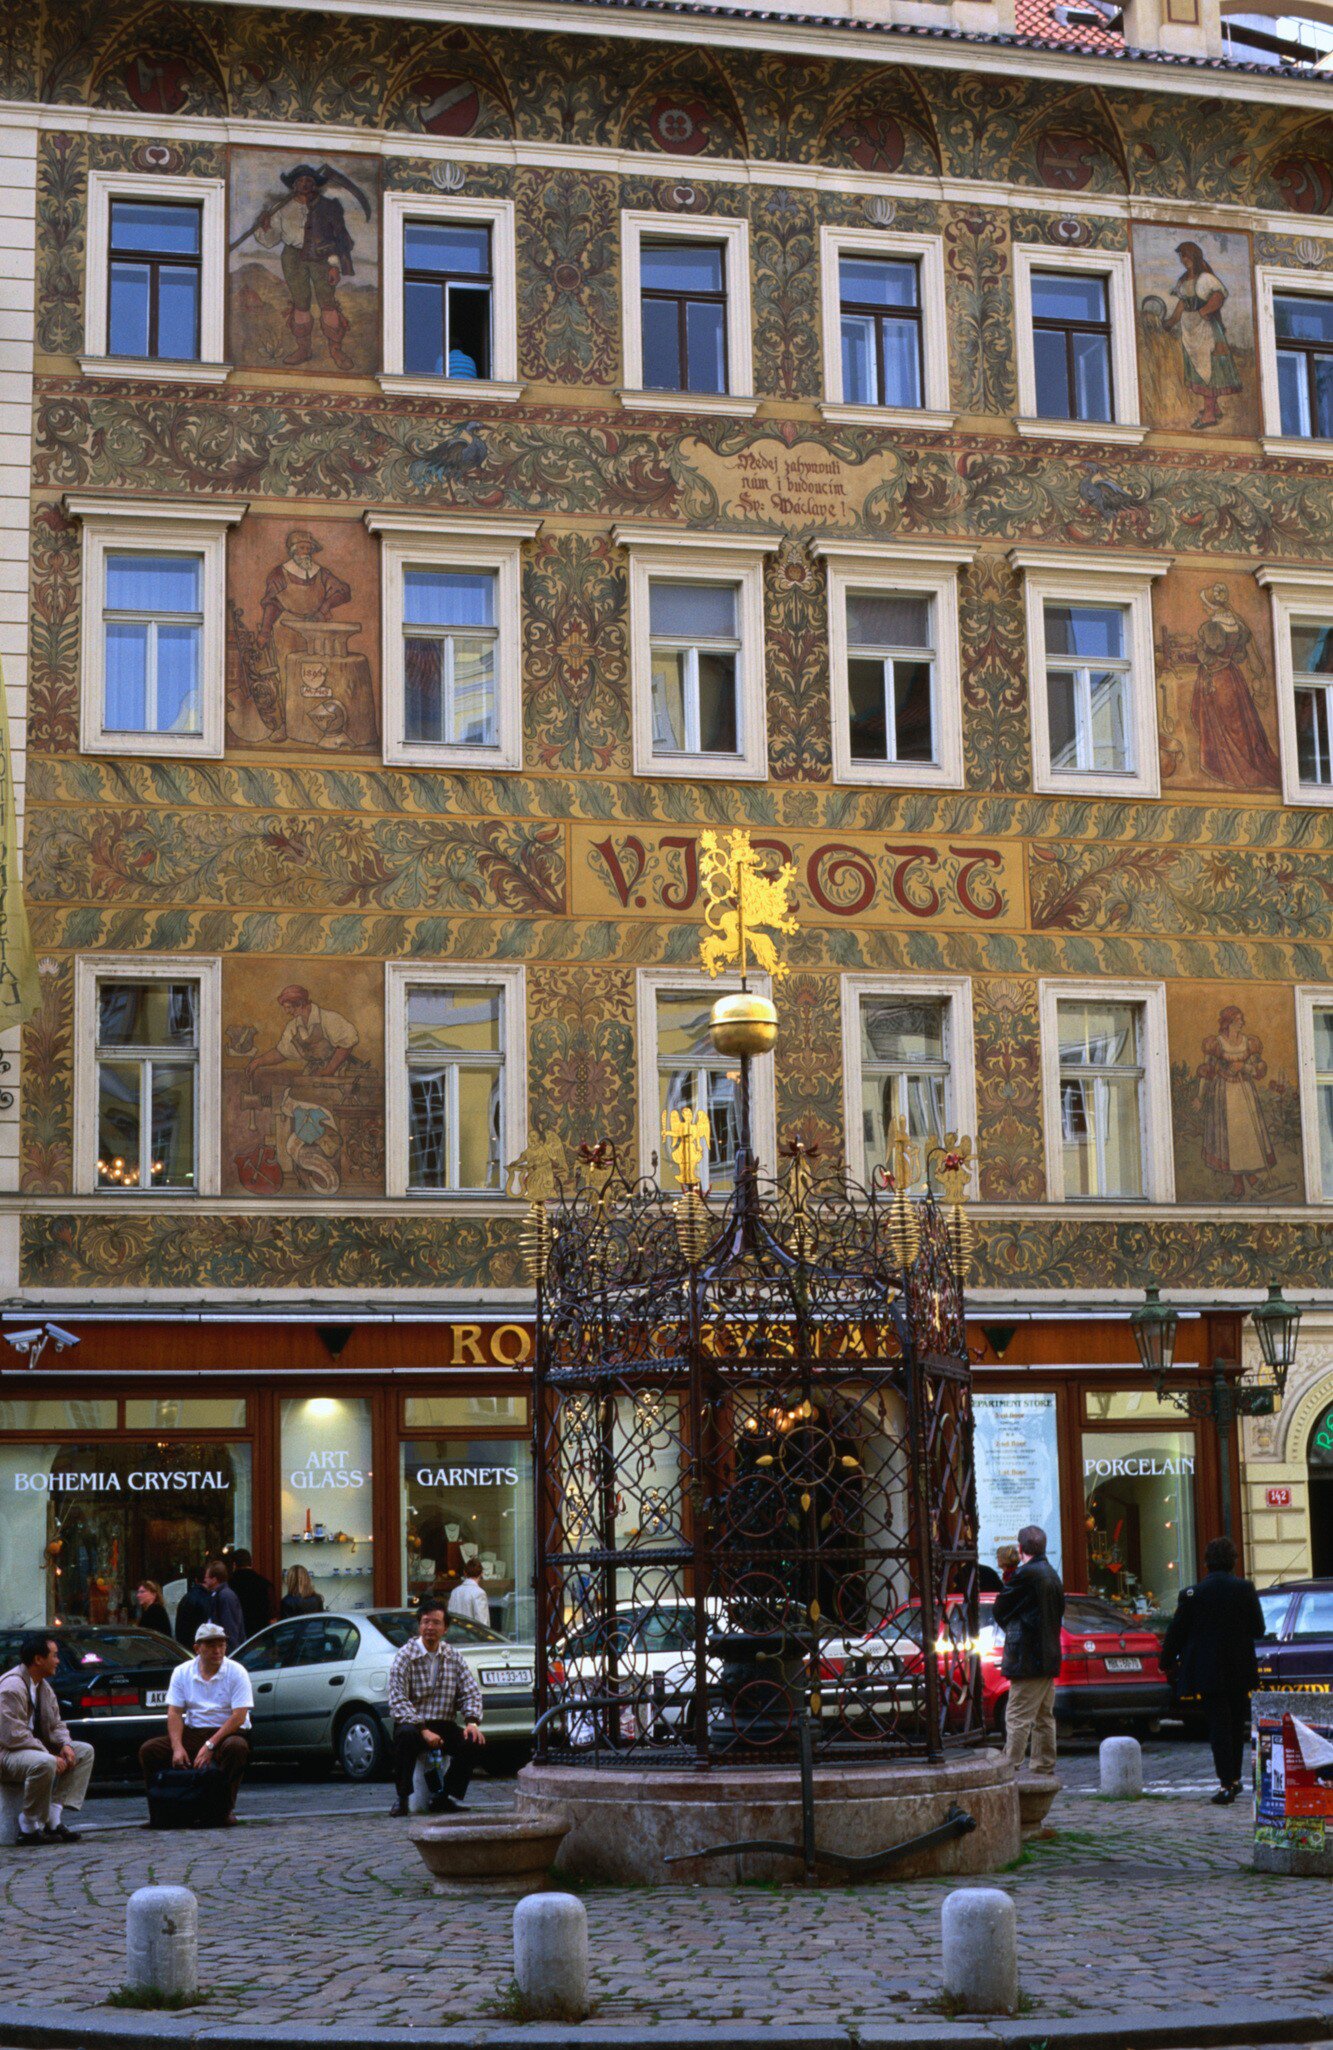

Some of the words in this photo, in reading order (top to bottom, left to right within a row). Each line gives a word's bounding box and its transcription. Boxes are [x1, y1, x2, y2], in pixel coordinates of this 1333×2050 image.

[742, 473, 771, 491] nám
[971, 1400, 1021, 1408] EPARTMENT
[305, 1451, 350, 1469] ART
[1084, 1457, 1195, 1477] PORCELAIN
[14, 1471, 121, 1492] BOHEMIA
[127, 1470, 230, 1491] CRYSTAL
[290, 1470, 364, 1489] GLASS
[416, 1467, 519, 1487] GARNETS
[1271, 1490, 1287, 1500] 142
